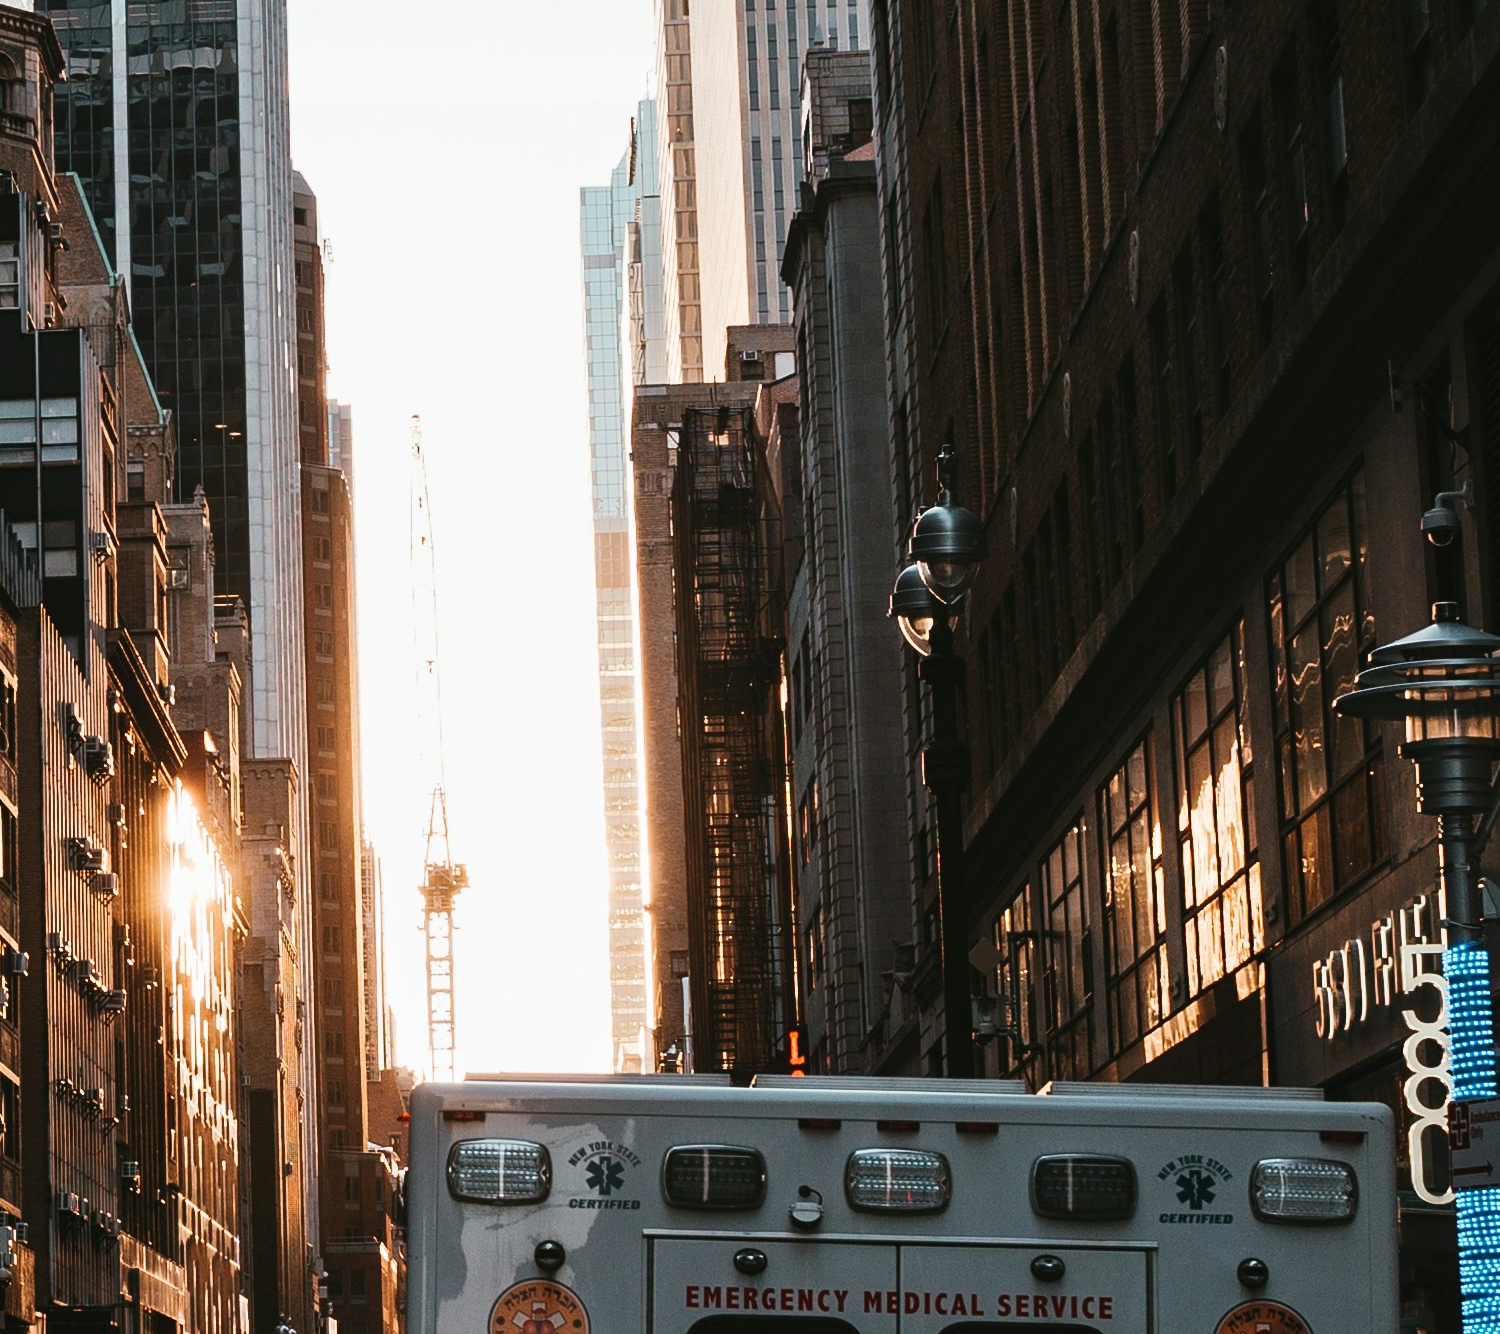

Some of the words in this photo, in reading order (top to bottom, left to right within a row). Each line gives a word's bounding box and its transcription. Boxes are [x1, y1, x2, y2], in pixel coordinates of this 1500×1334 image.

[568, 1147, 587, 1167] NEW
[588, 1141, 613, 1152] YORK
[616, 1145, 642, 1168] STATE
[1157, 1161, 1177, 1181] NEW
[1177, 1155, 1203, 1166] YORK
[1206, 1158, 1233, 1182] STATE
[569, 1198, 641, 1210] CERTIFIED
[1159, 1213, 1234, 1224] CERTIFIED
[686, 1285, 849, 1314] EMERGENCY
[862, 1290, 984, 1317] MEDICAL
[998, 1294, 1115, 1320] SERVICE
